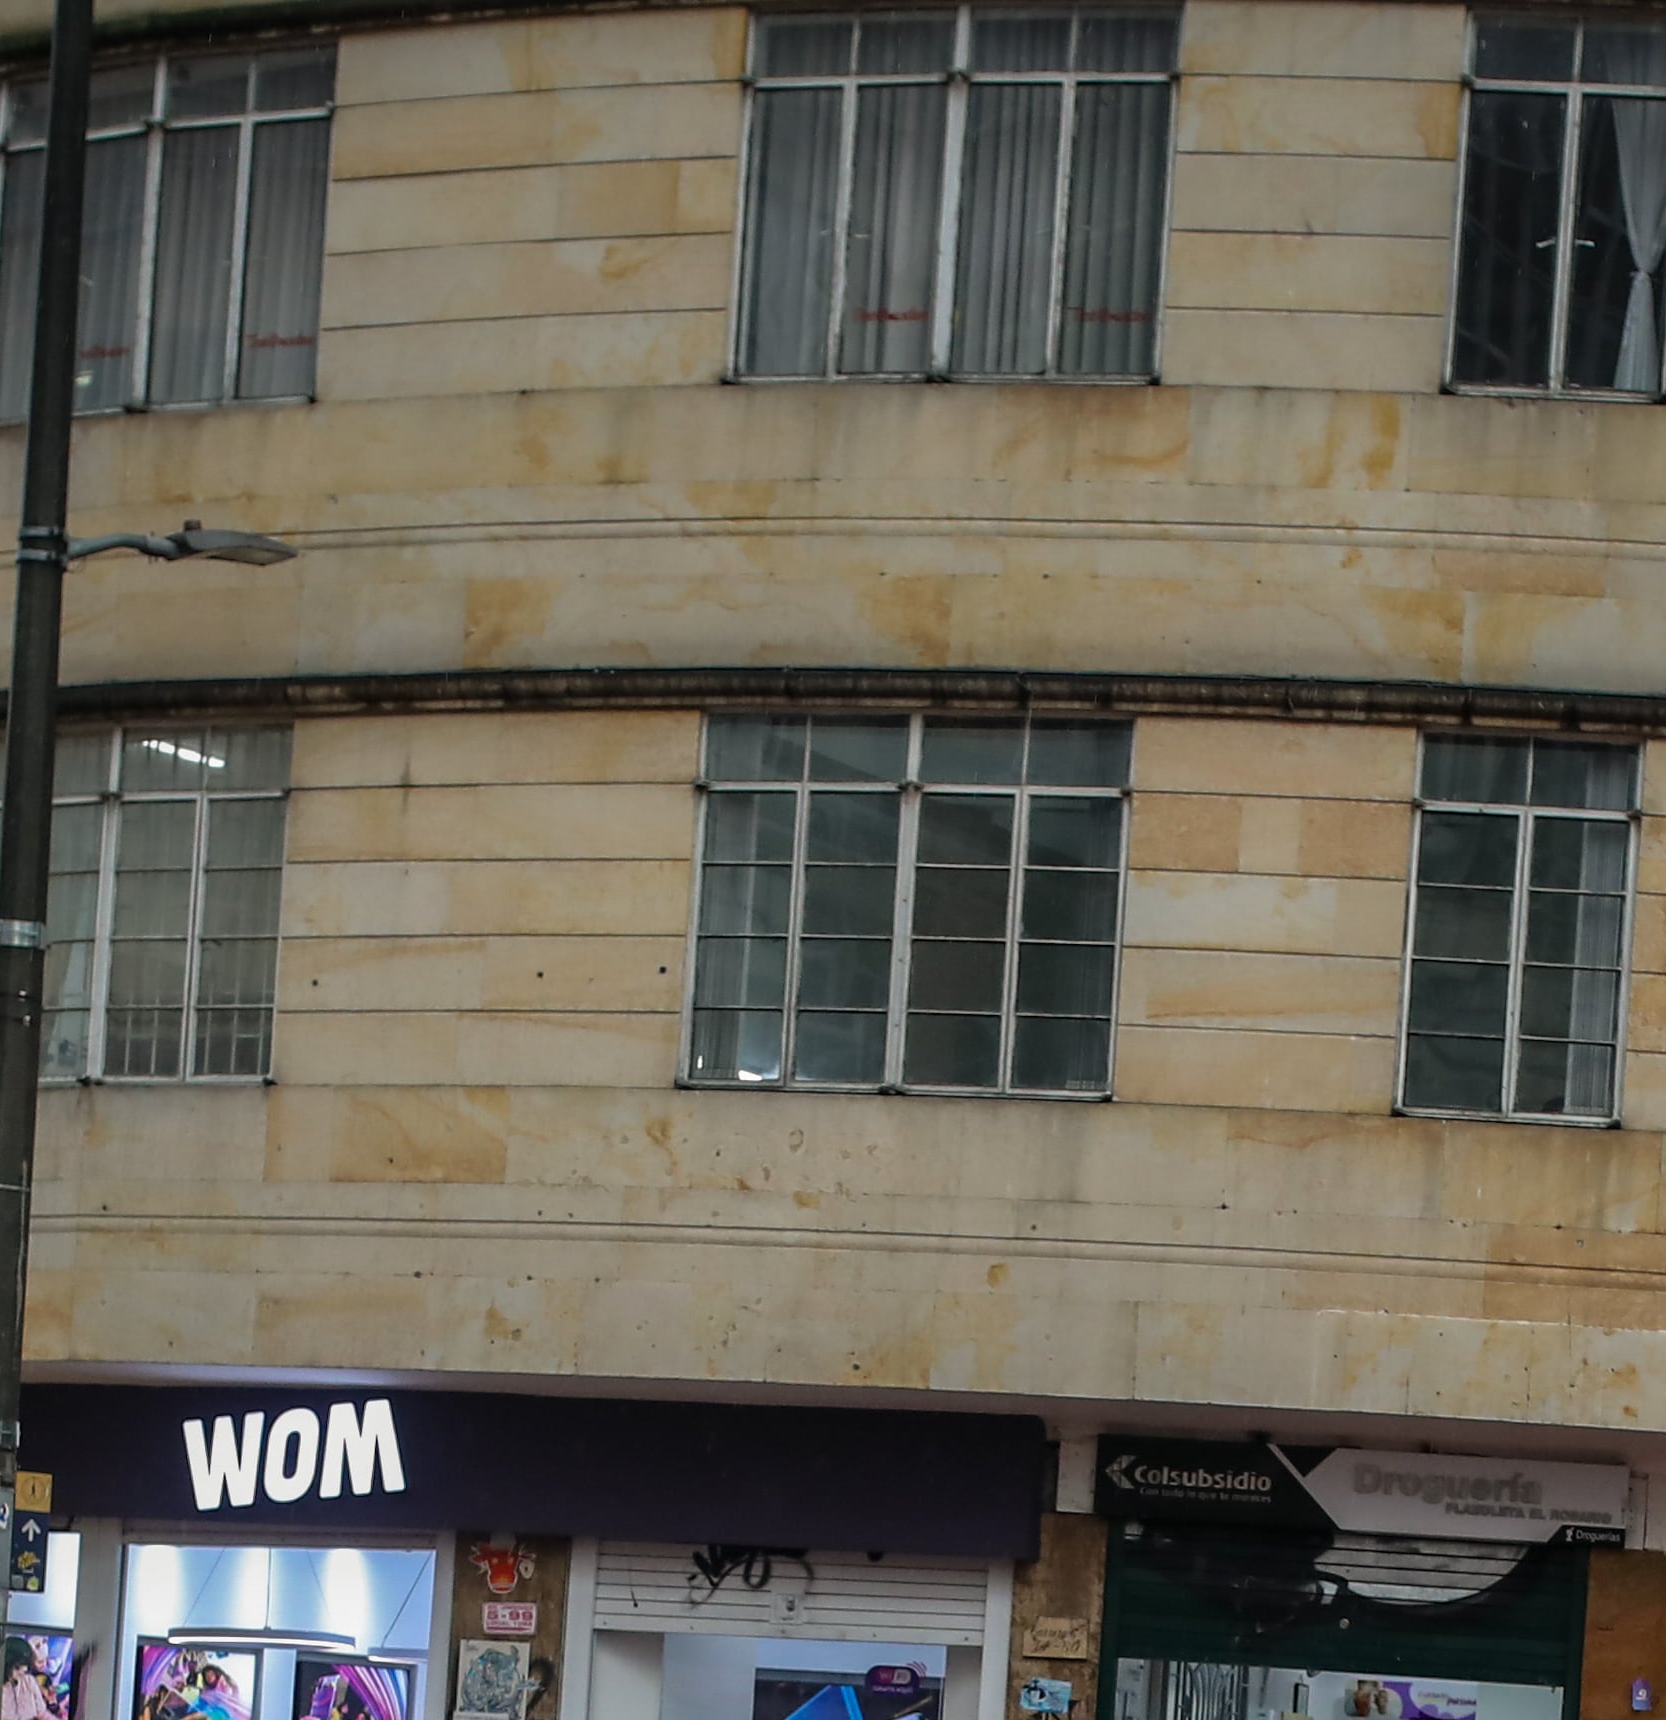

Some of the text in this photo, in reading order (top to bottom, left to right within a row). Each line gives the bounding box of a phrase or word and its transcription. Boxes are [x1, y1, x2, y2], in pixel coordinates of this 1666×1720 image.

[182, 1398, 406, 1511] WOM
[1134, 1464, 1273, 1492] Colsubsidio
[1353, 1463, 1543, 1505] Droguería
[1575, 1528, 1622, 1542] Droguerías
